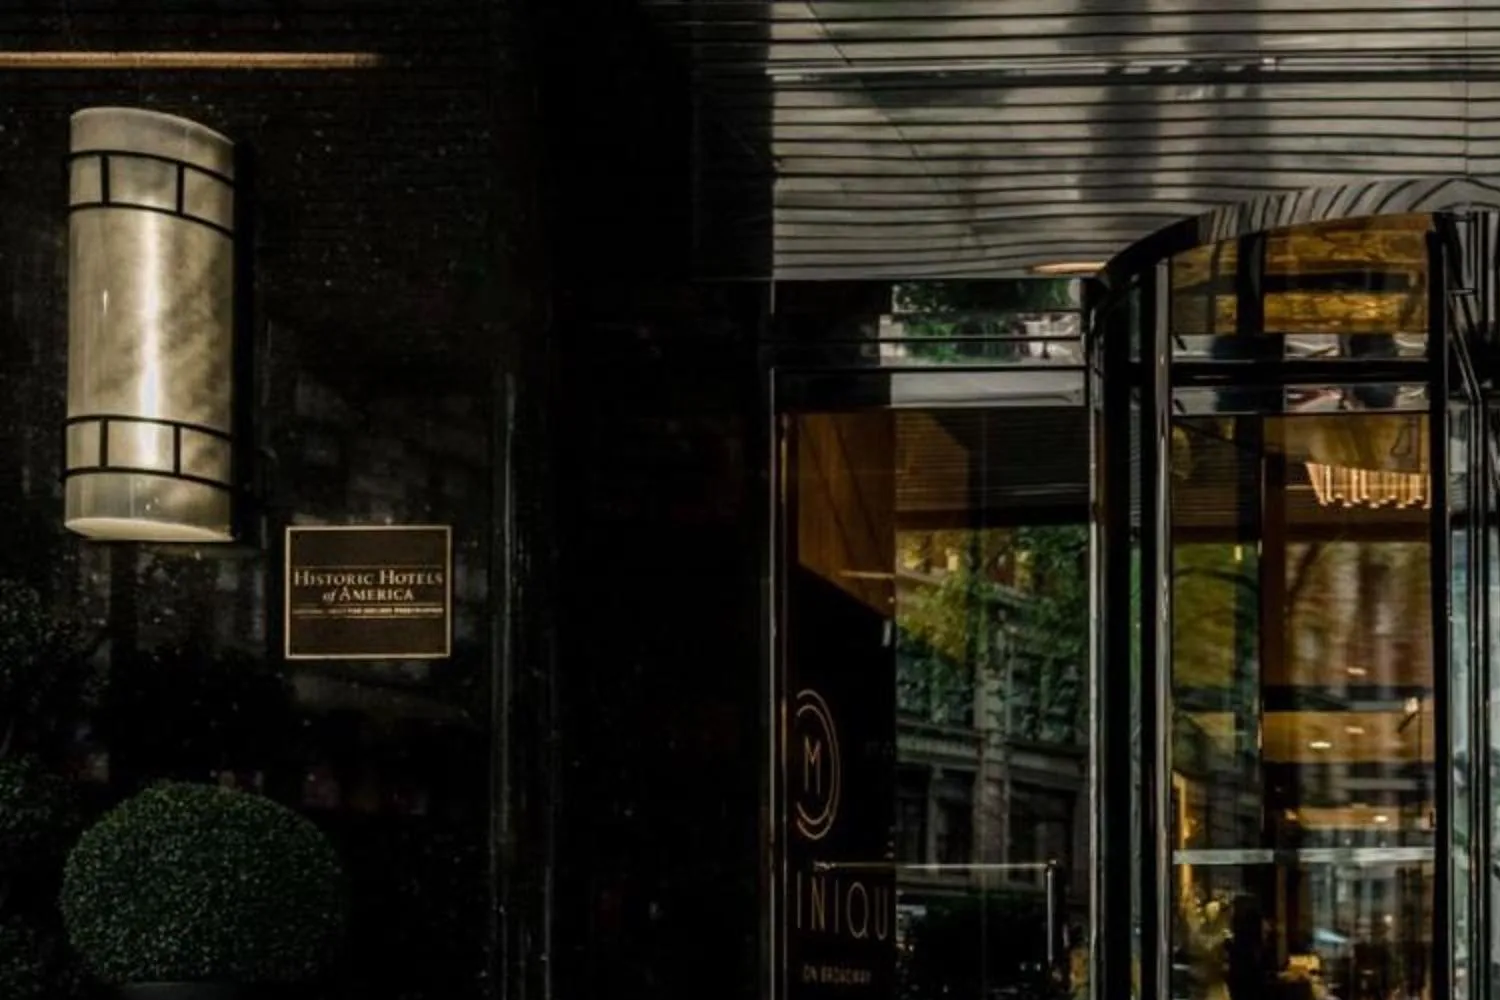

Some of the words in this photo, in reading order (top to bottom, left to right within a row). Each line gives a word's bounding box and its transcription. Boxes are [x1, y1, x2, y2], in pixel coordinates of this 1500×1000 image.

[294, 569, 375, 586] HISTORIC
[379, 569, 444, 585] HOTELS
[339, 586, 414, 601] AMERICA
